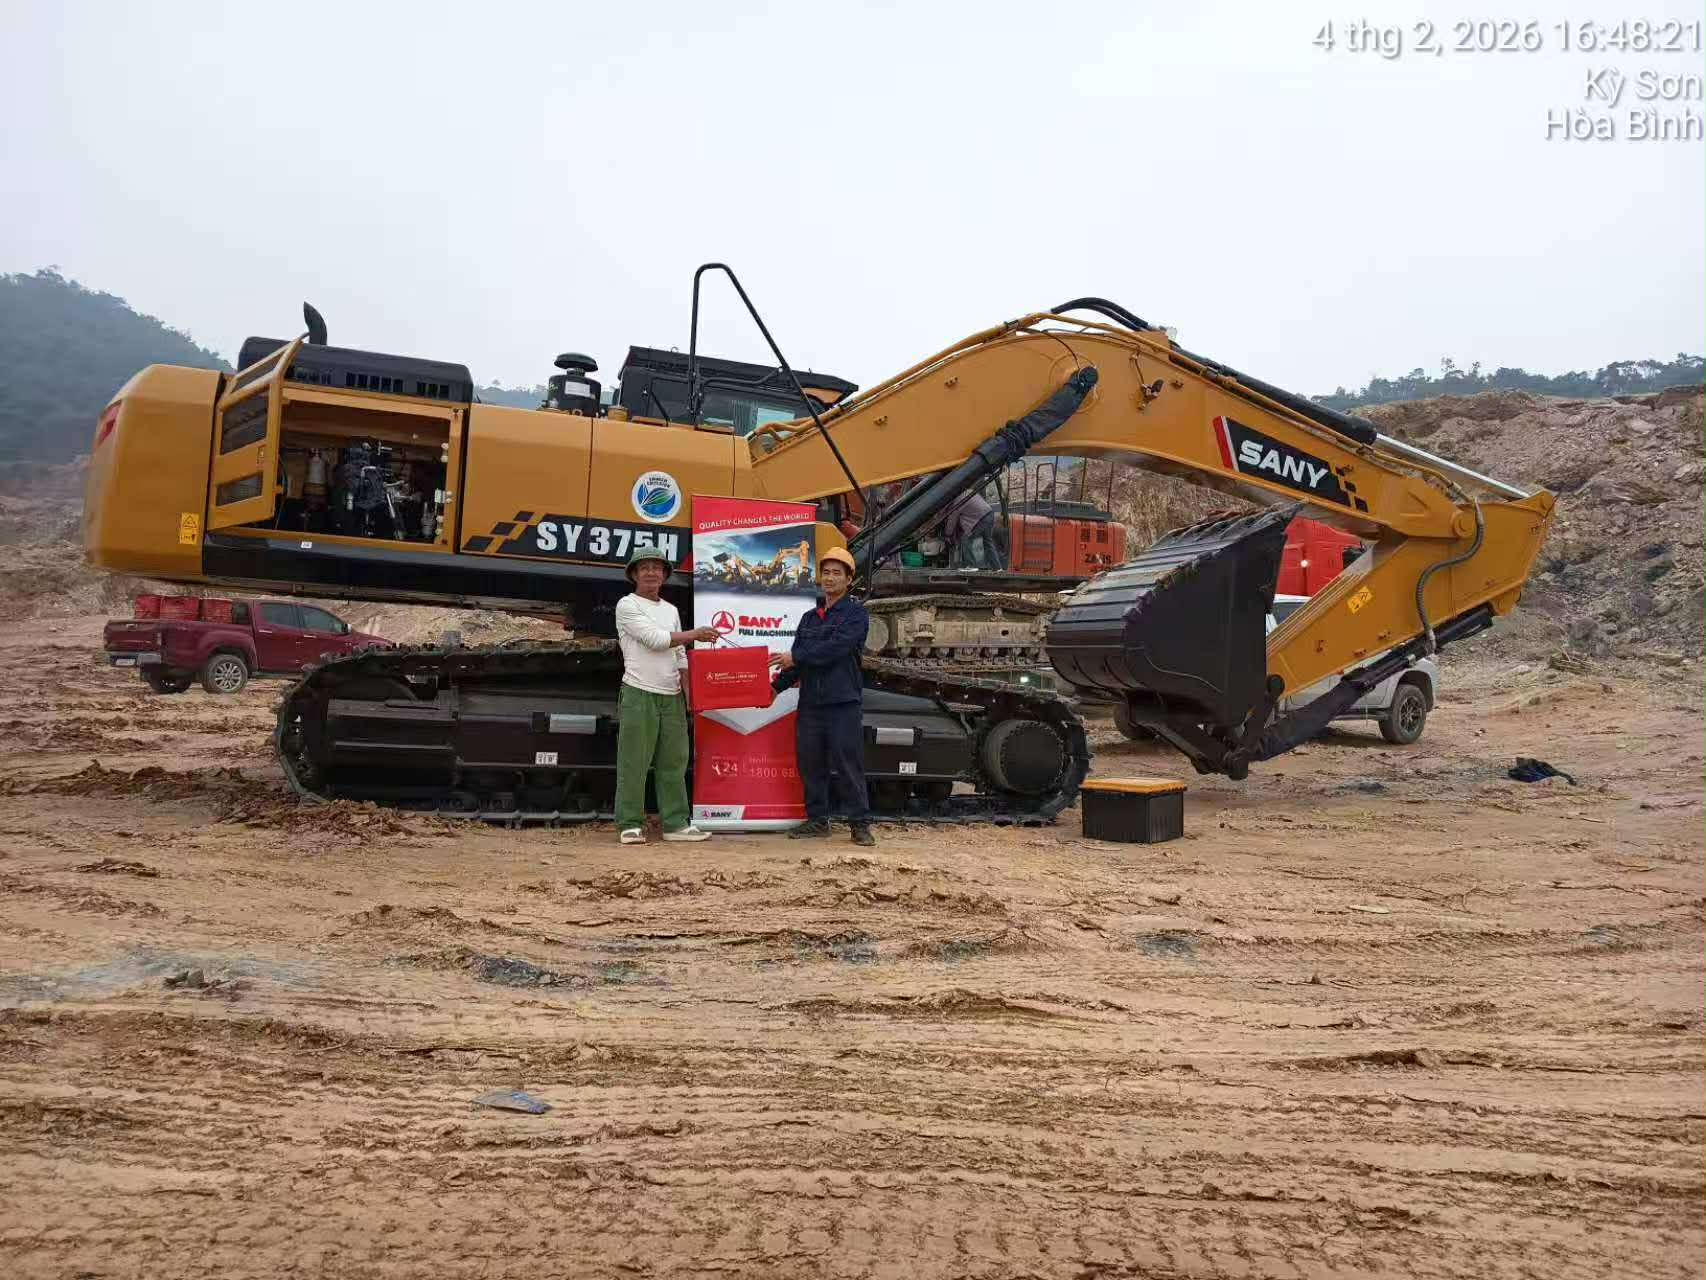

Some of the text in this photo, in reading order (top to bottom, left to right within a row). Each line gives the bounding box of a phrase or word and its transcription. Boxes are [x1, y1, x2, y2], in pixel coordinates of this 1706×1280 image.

[1238, 439, 1329, 489] SANY
[698, 518, 733, 531] QUALITY
[733, 515, 768, 526] CHANGES
[783, 512, 810, 521] WORLD
[738, 615, 783, 628] SANY
